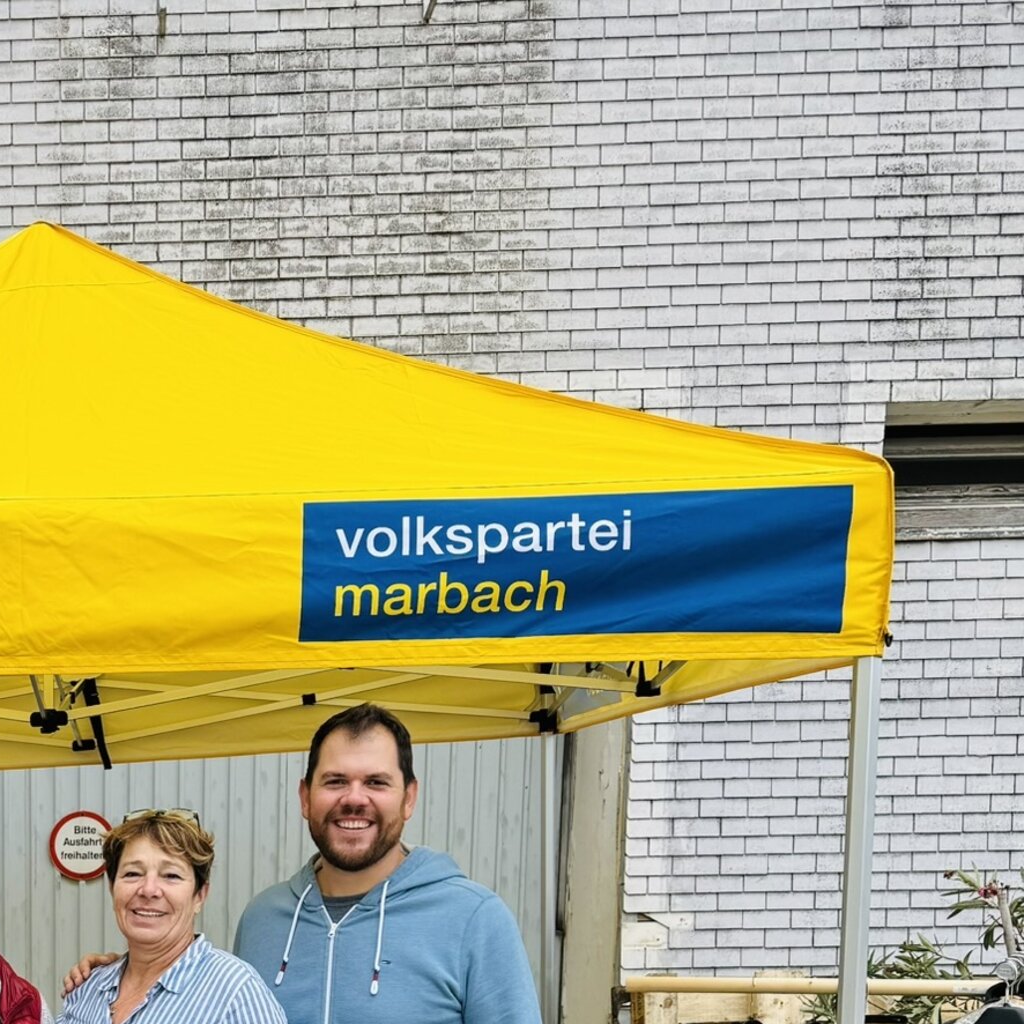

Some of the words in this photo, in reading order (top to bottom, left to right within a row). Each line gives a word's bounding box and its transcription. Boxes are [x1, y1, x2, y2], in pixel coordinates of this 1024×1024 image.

[335, 509, 632, 563] volkspartei
[333, 569, 566, 617] marbach
[63, 838, 102, 846] Ausfahrt
[74, 826, 96, 834] Bitte
